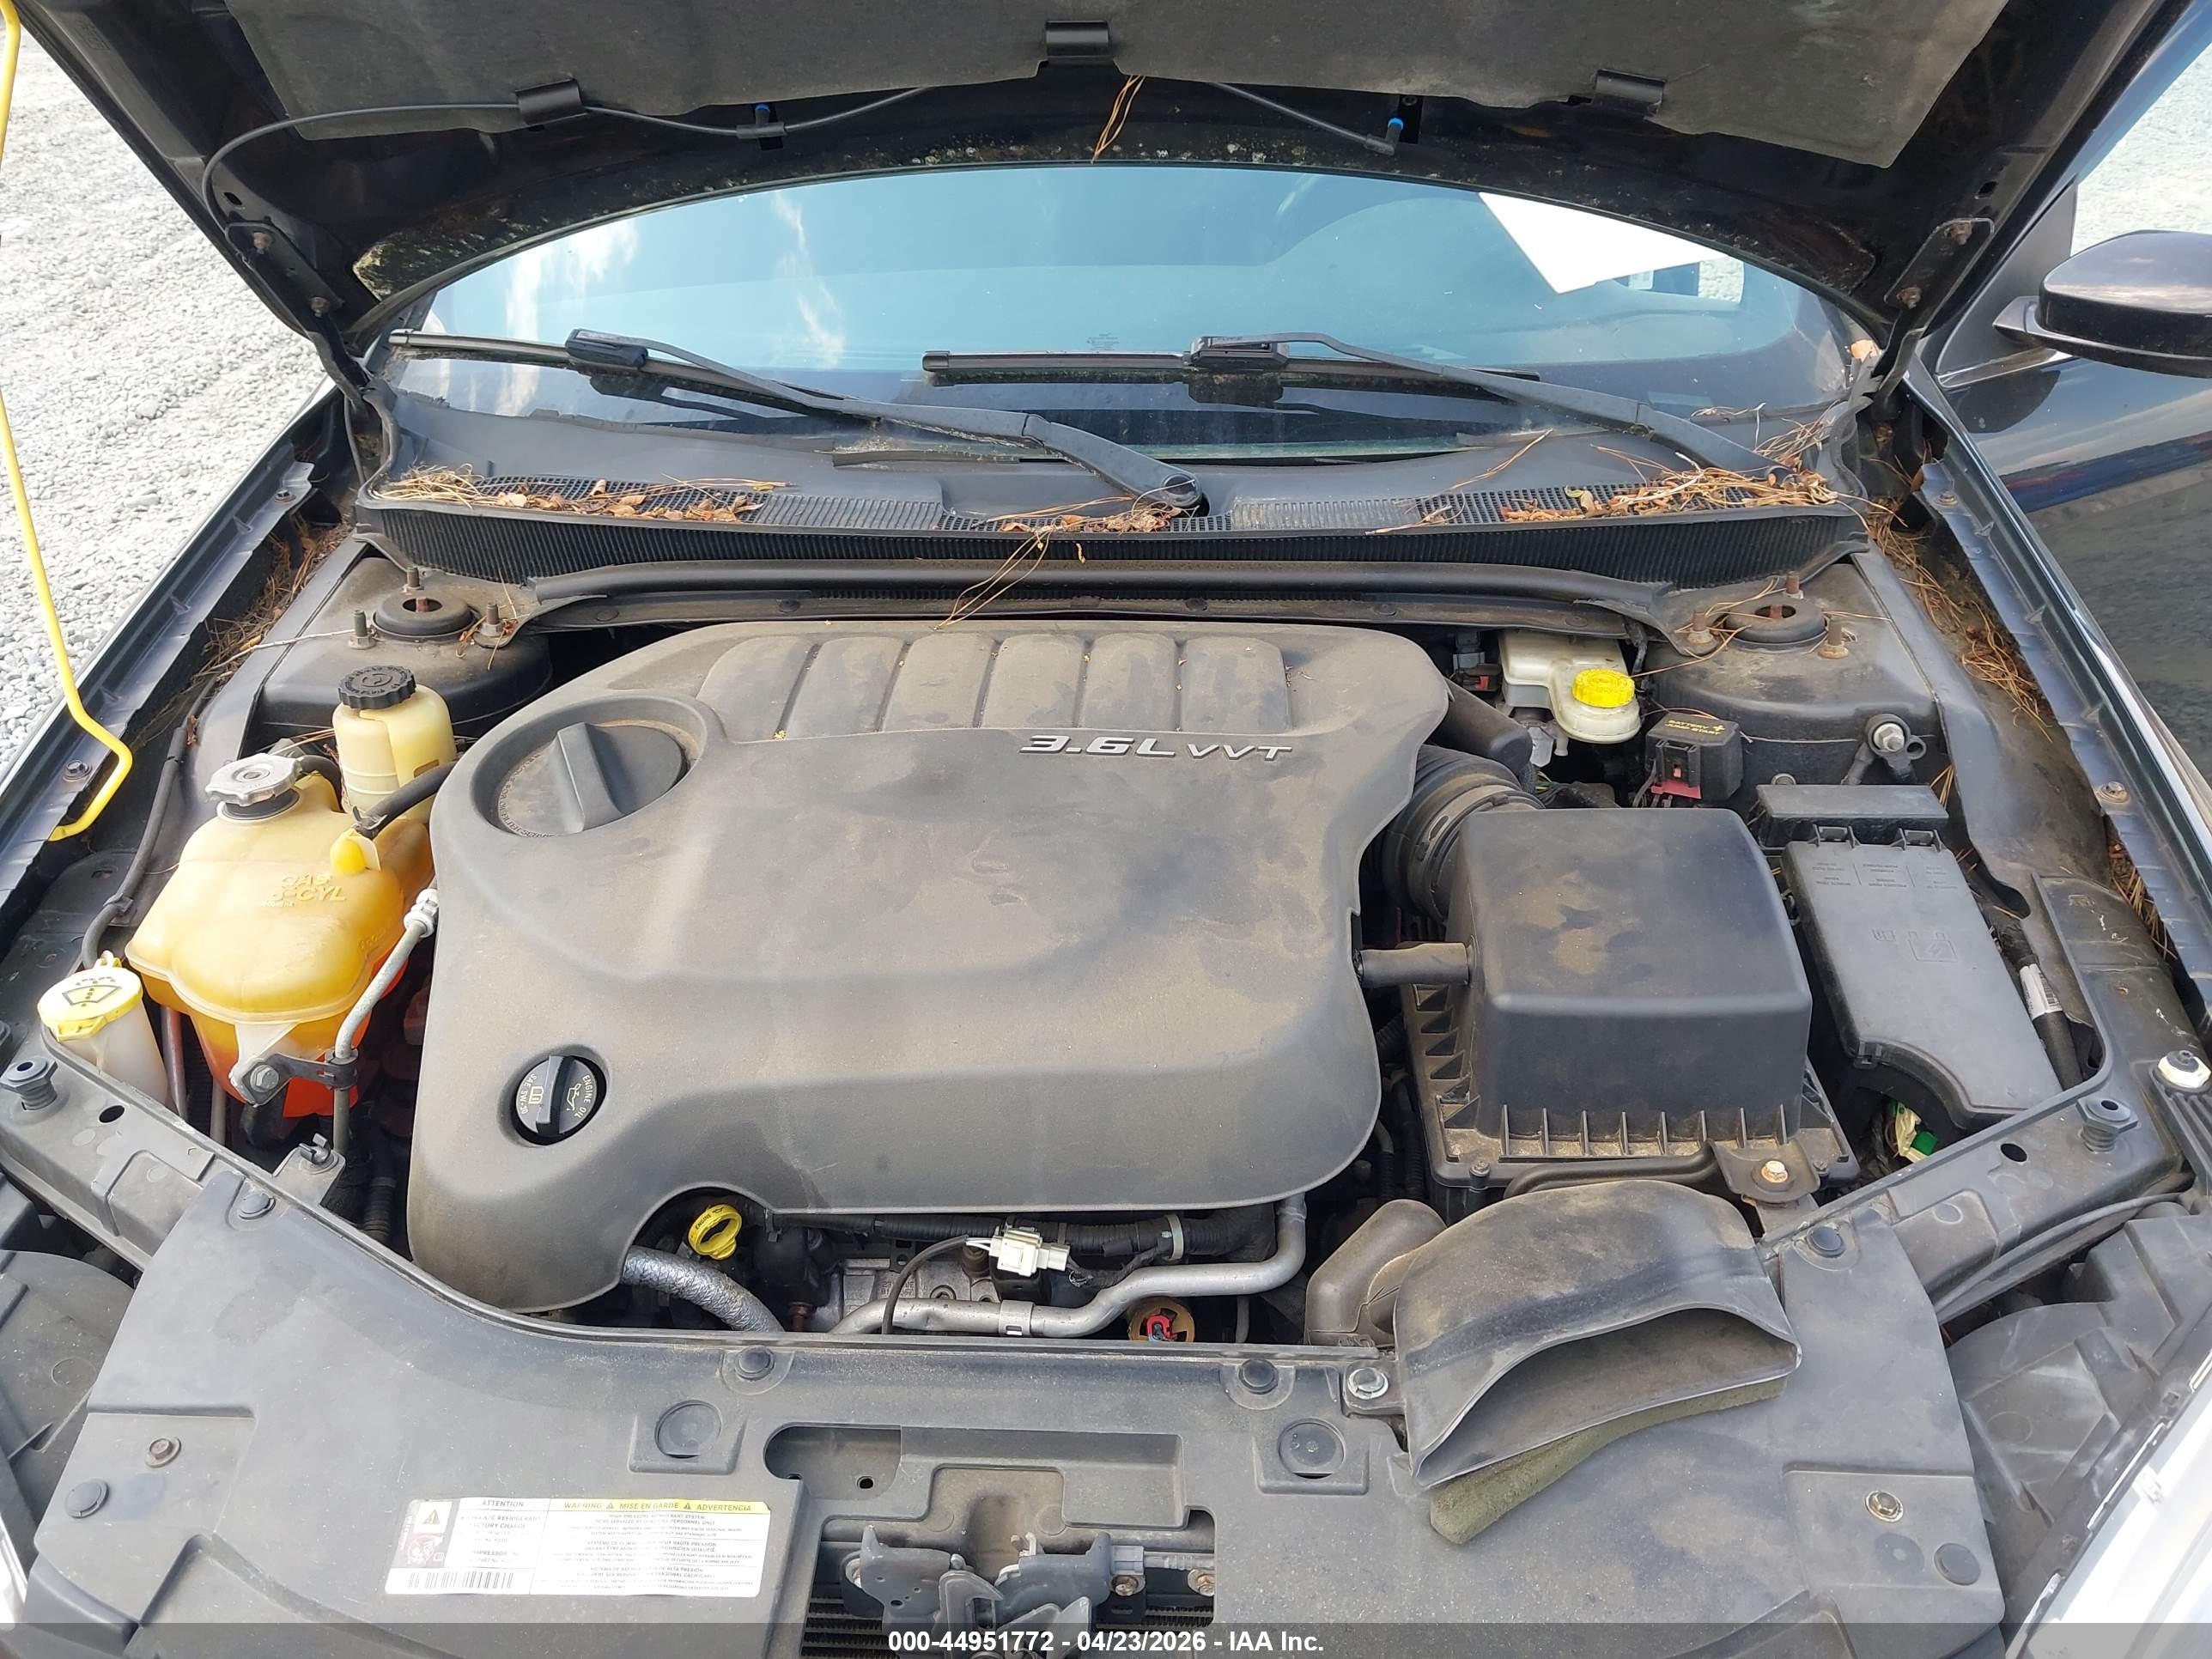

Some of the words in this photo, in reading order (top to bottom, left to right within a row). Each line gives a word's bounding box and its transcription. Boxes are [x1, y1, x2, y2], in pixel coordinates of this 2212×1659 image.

[1668, 720, 1710, 729] BATTERY
[1019, 733, 1176, 757] 3.6L
[1187, 743, 1293, 762] VVT
[525, 1073, 538, 1088] SAE
[582, 1074, 593, 1103] ENGINE
[574, 1106, 587, 1119] OIL
[696, 1504, 752, 1512] ADVERTENCIA
